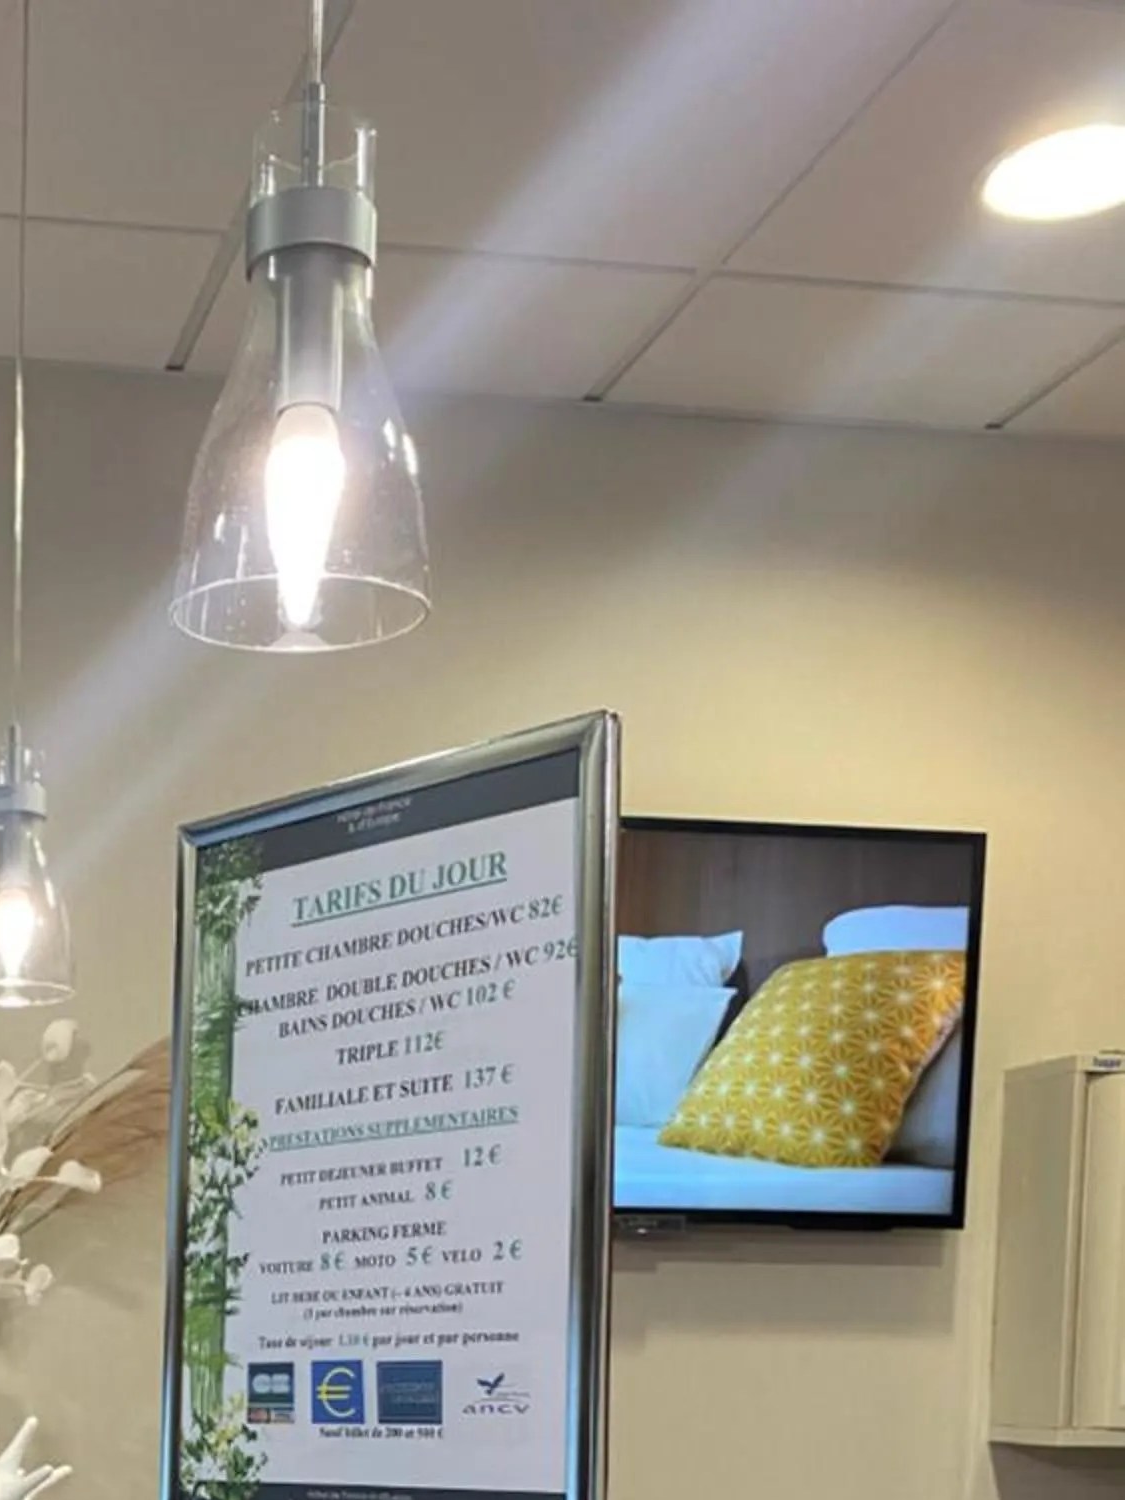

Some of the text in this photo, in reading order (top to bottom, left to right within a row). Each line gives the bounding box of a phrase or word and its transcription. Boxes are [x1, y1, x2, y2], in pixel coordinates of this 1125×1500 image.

[291, 850, 507, 922] TARIFS DU JOUR
[245, 950, 302, 977] PETITE
[305, 931, 393, 964] CHAMBRE
[528, 894, 564, 921] 82€
[326, 972, 397, 1001] DOUBLE
[401, 954, 491, 988] DOUCHES
[505, 945, 539, 969] WC
[278, 1015, 327, 1038] BAINS
[332, 998, 416, 1029] DOUCHES
[429, 989, 462, 1012] WC
[466, 982, 497, 1006] 102
[336, 1040, 399, 1065] TRIPLE
[275, 1086, 369, 1115] FAMILIALE
[373, 1082, 396, 1102] ET
[399, 1074, 454, 1098] SUITE
[464, 1066, 496, 1089] 137
[280, 1170, 316, 1186] PETIT
[389, 1157, 443, 1175] BUFFET
[464, 1146, 483, 1167] 12
[319, 1194, 356, 1210] PETIT
[361, 1190, 414, 1206] ANIMAL
[425, 1181, 436, 1200] 8
[321, 1226, 390, 1244] PARKING
[259, 1260, 314, 1274] VOITURE
[320, 1252, 331, 1271] 8
[354, 1254, 396, 1269] MOTO
[406, 1246, 418, 1266] 5
[493, 1240, 504, 1261] 2
[462, 1331, 520, 1347] personne
